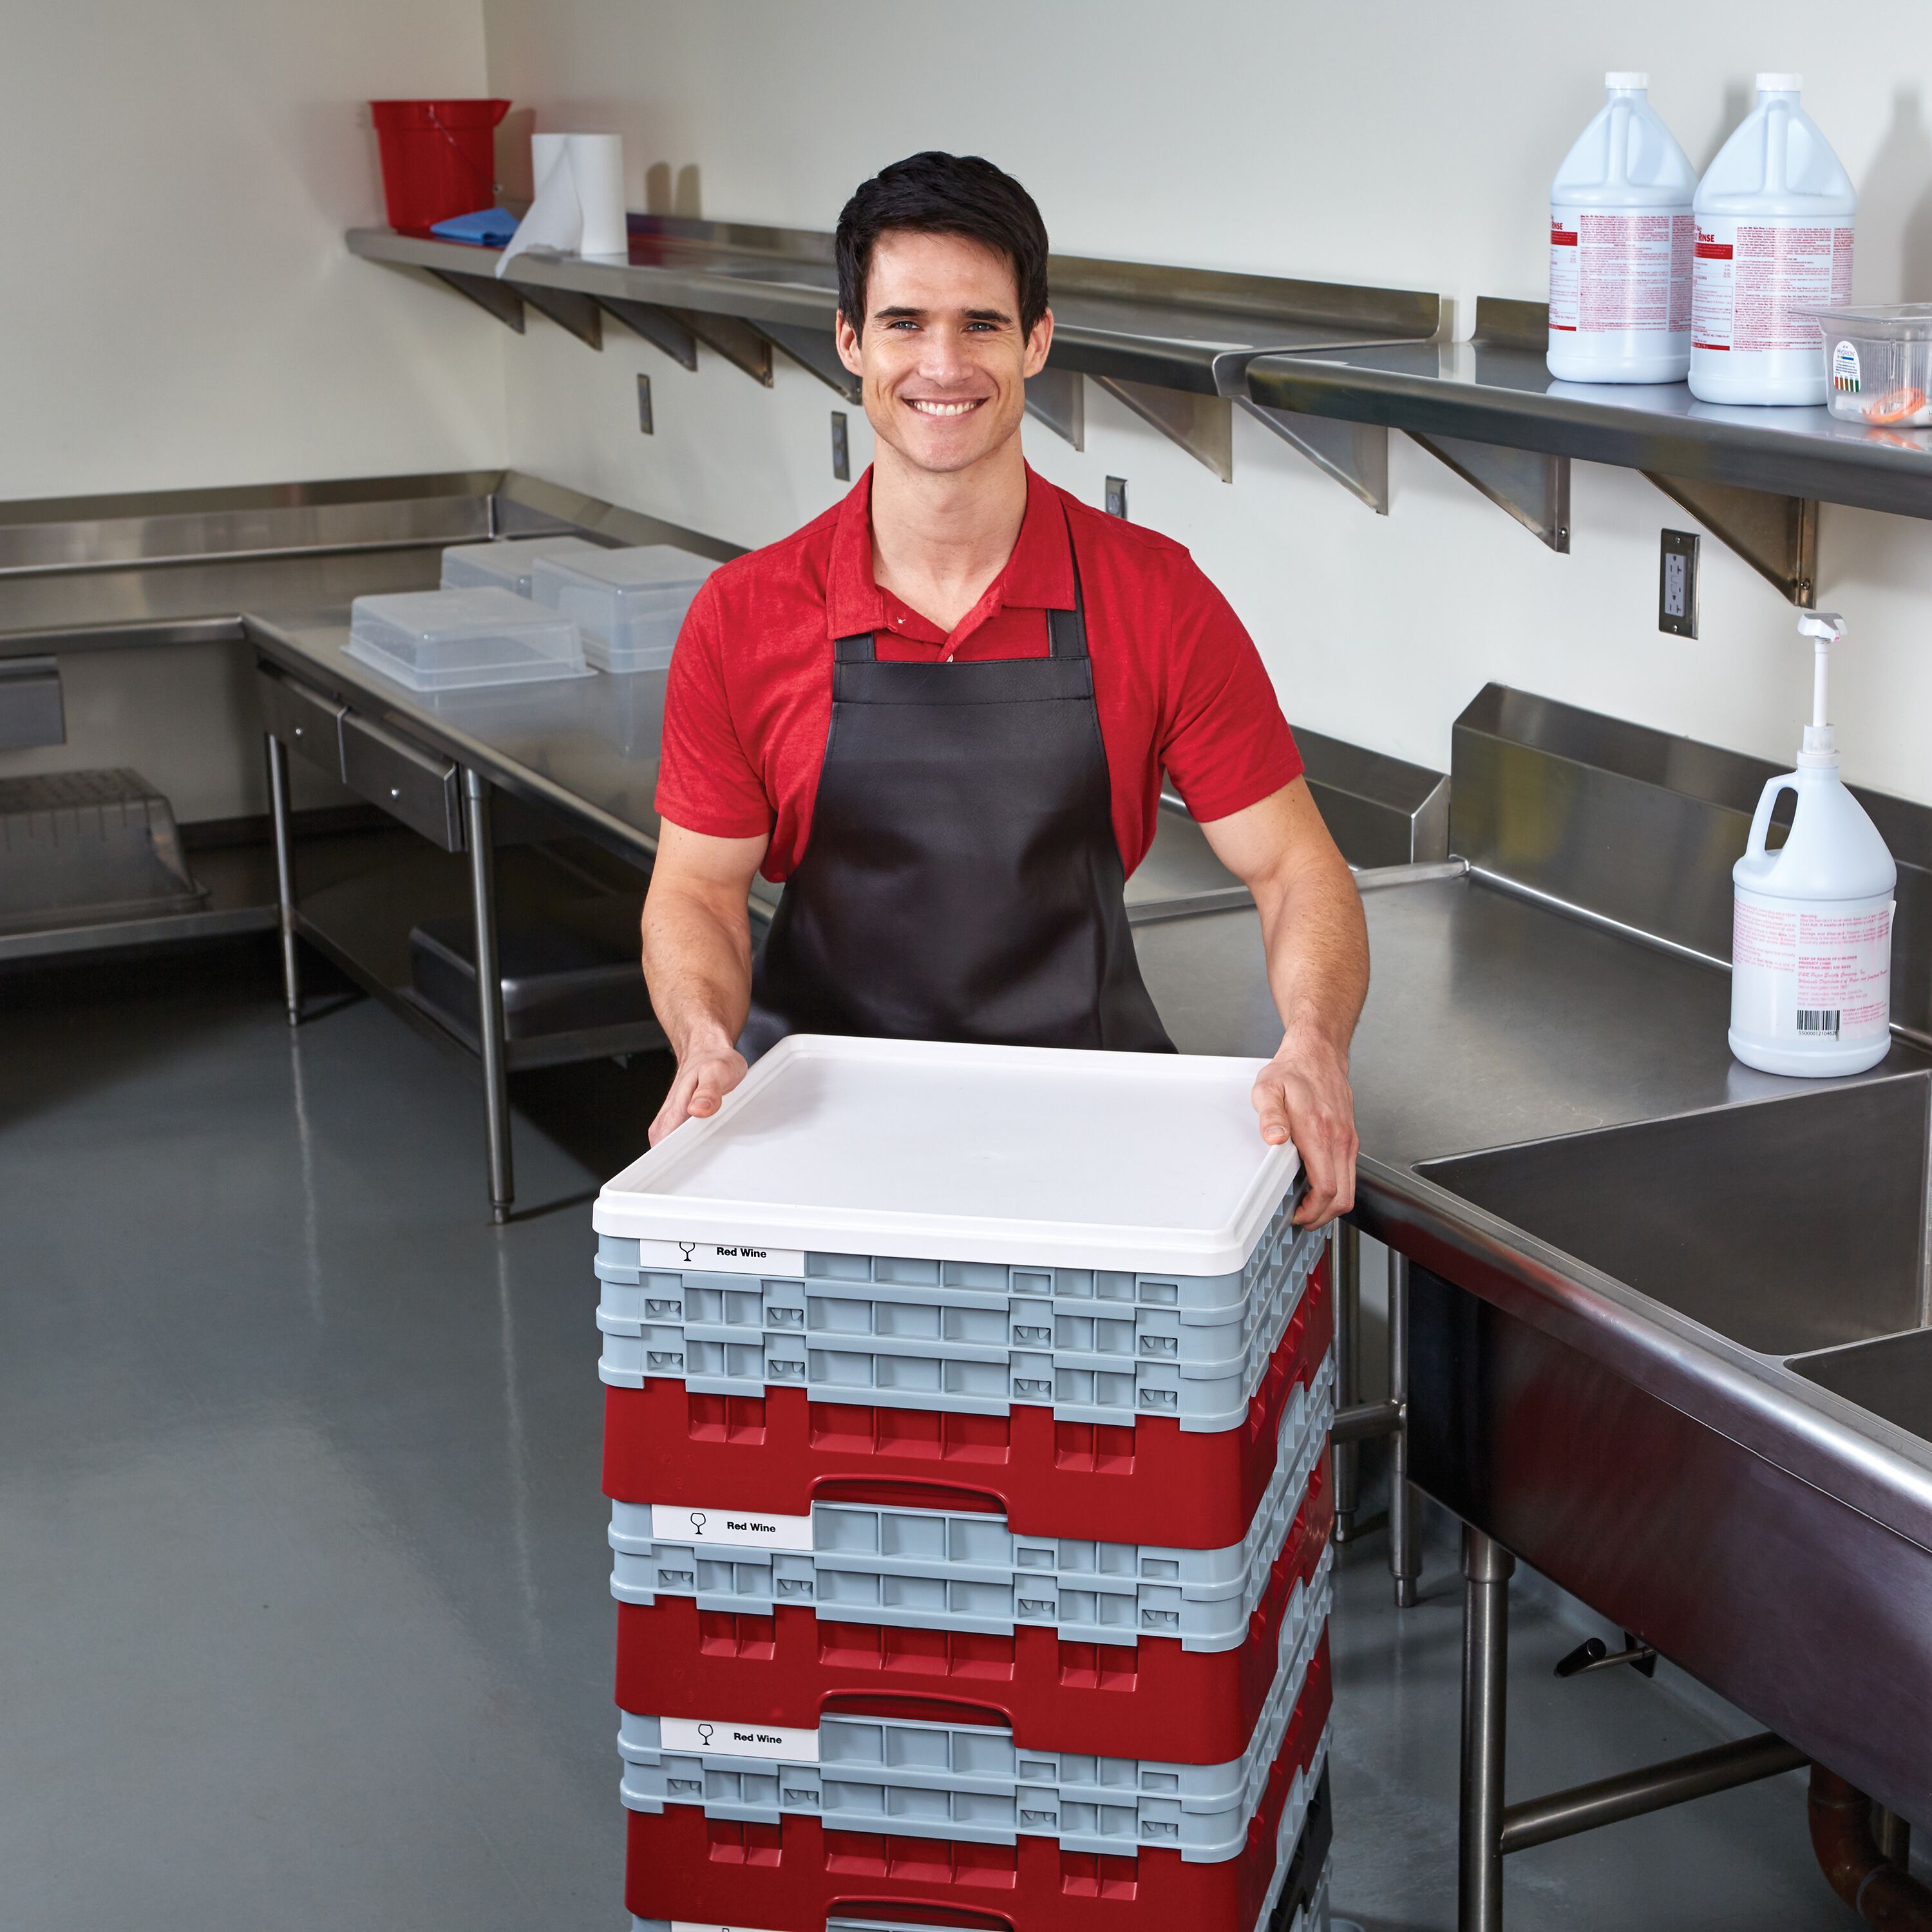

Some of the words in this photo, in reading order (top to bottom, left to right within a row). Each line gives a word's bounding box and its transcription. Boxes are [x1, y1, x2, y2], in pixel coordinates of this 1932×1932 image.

[1698, 232, 1715, 242] RINSE
[716, 1246, 737, 1256] Red
[740, 1248, 767, 1258] Wine
[727, 1521, 747, 1531] Red
[750, 1523, 776, 1533] Wine
[734, 1732, 753, 1741] Red
[757, 1734, 782, 1744] Wine
